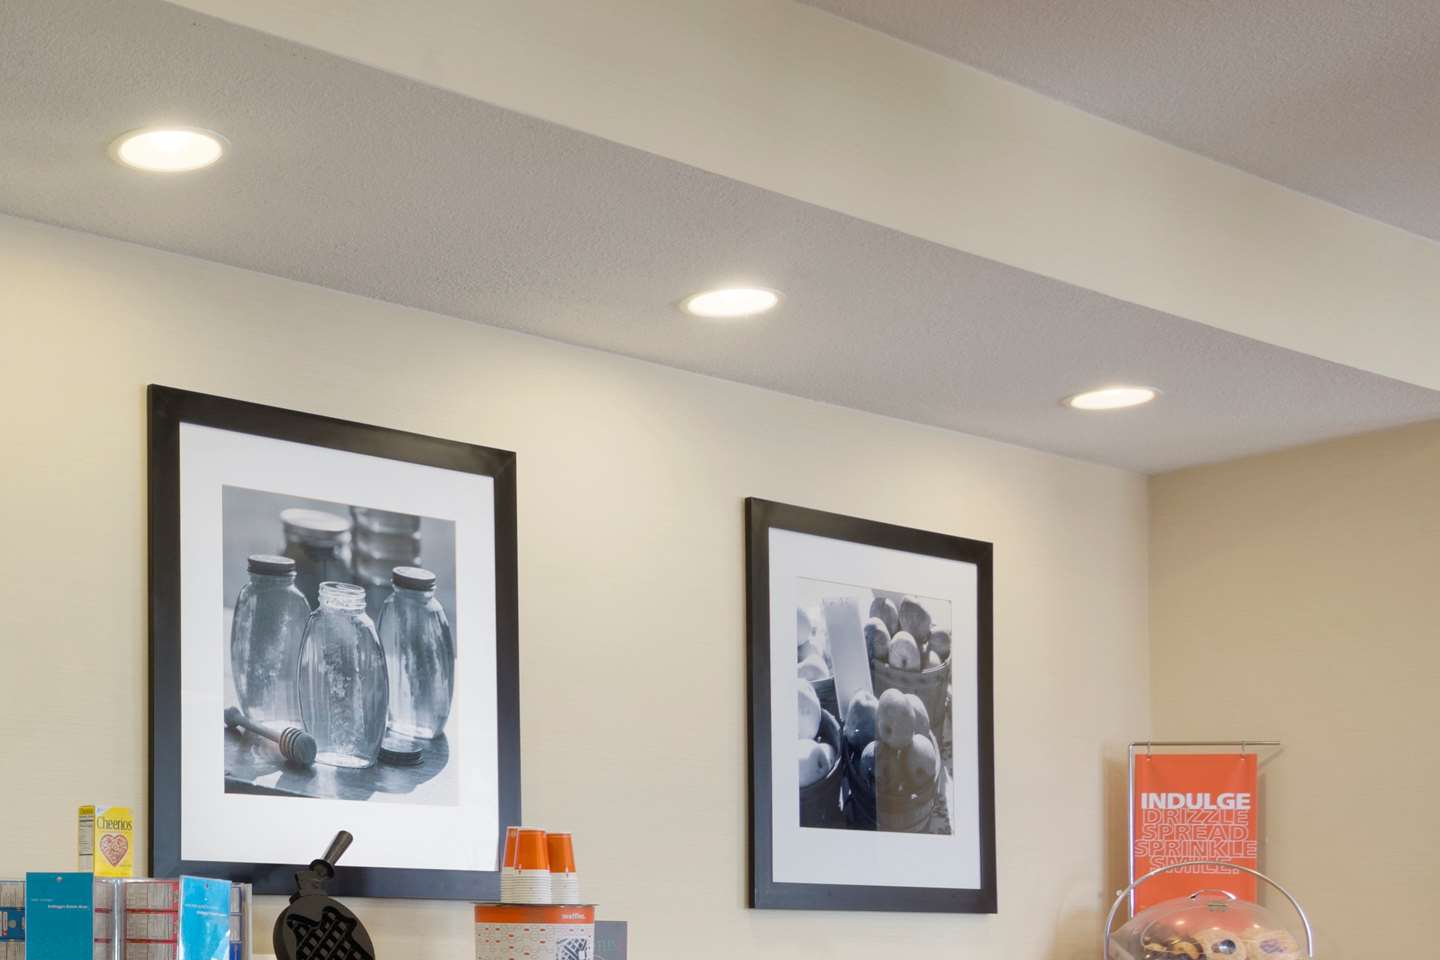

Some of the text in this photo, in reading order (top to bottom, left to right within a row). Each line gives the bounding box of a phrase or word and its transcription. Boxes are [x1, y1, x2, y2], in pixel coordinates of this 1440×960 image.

[1141, 792, 1251, 810] INDULGE
[96, 816, 133, 831] Cheerios
[1143, 808, 1249, 826] DRIZZLE
[1143, 824, 1249, 841] SPREAD
[1135, 840, 1257, 859] SPRINKLE
